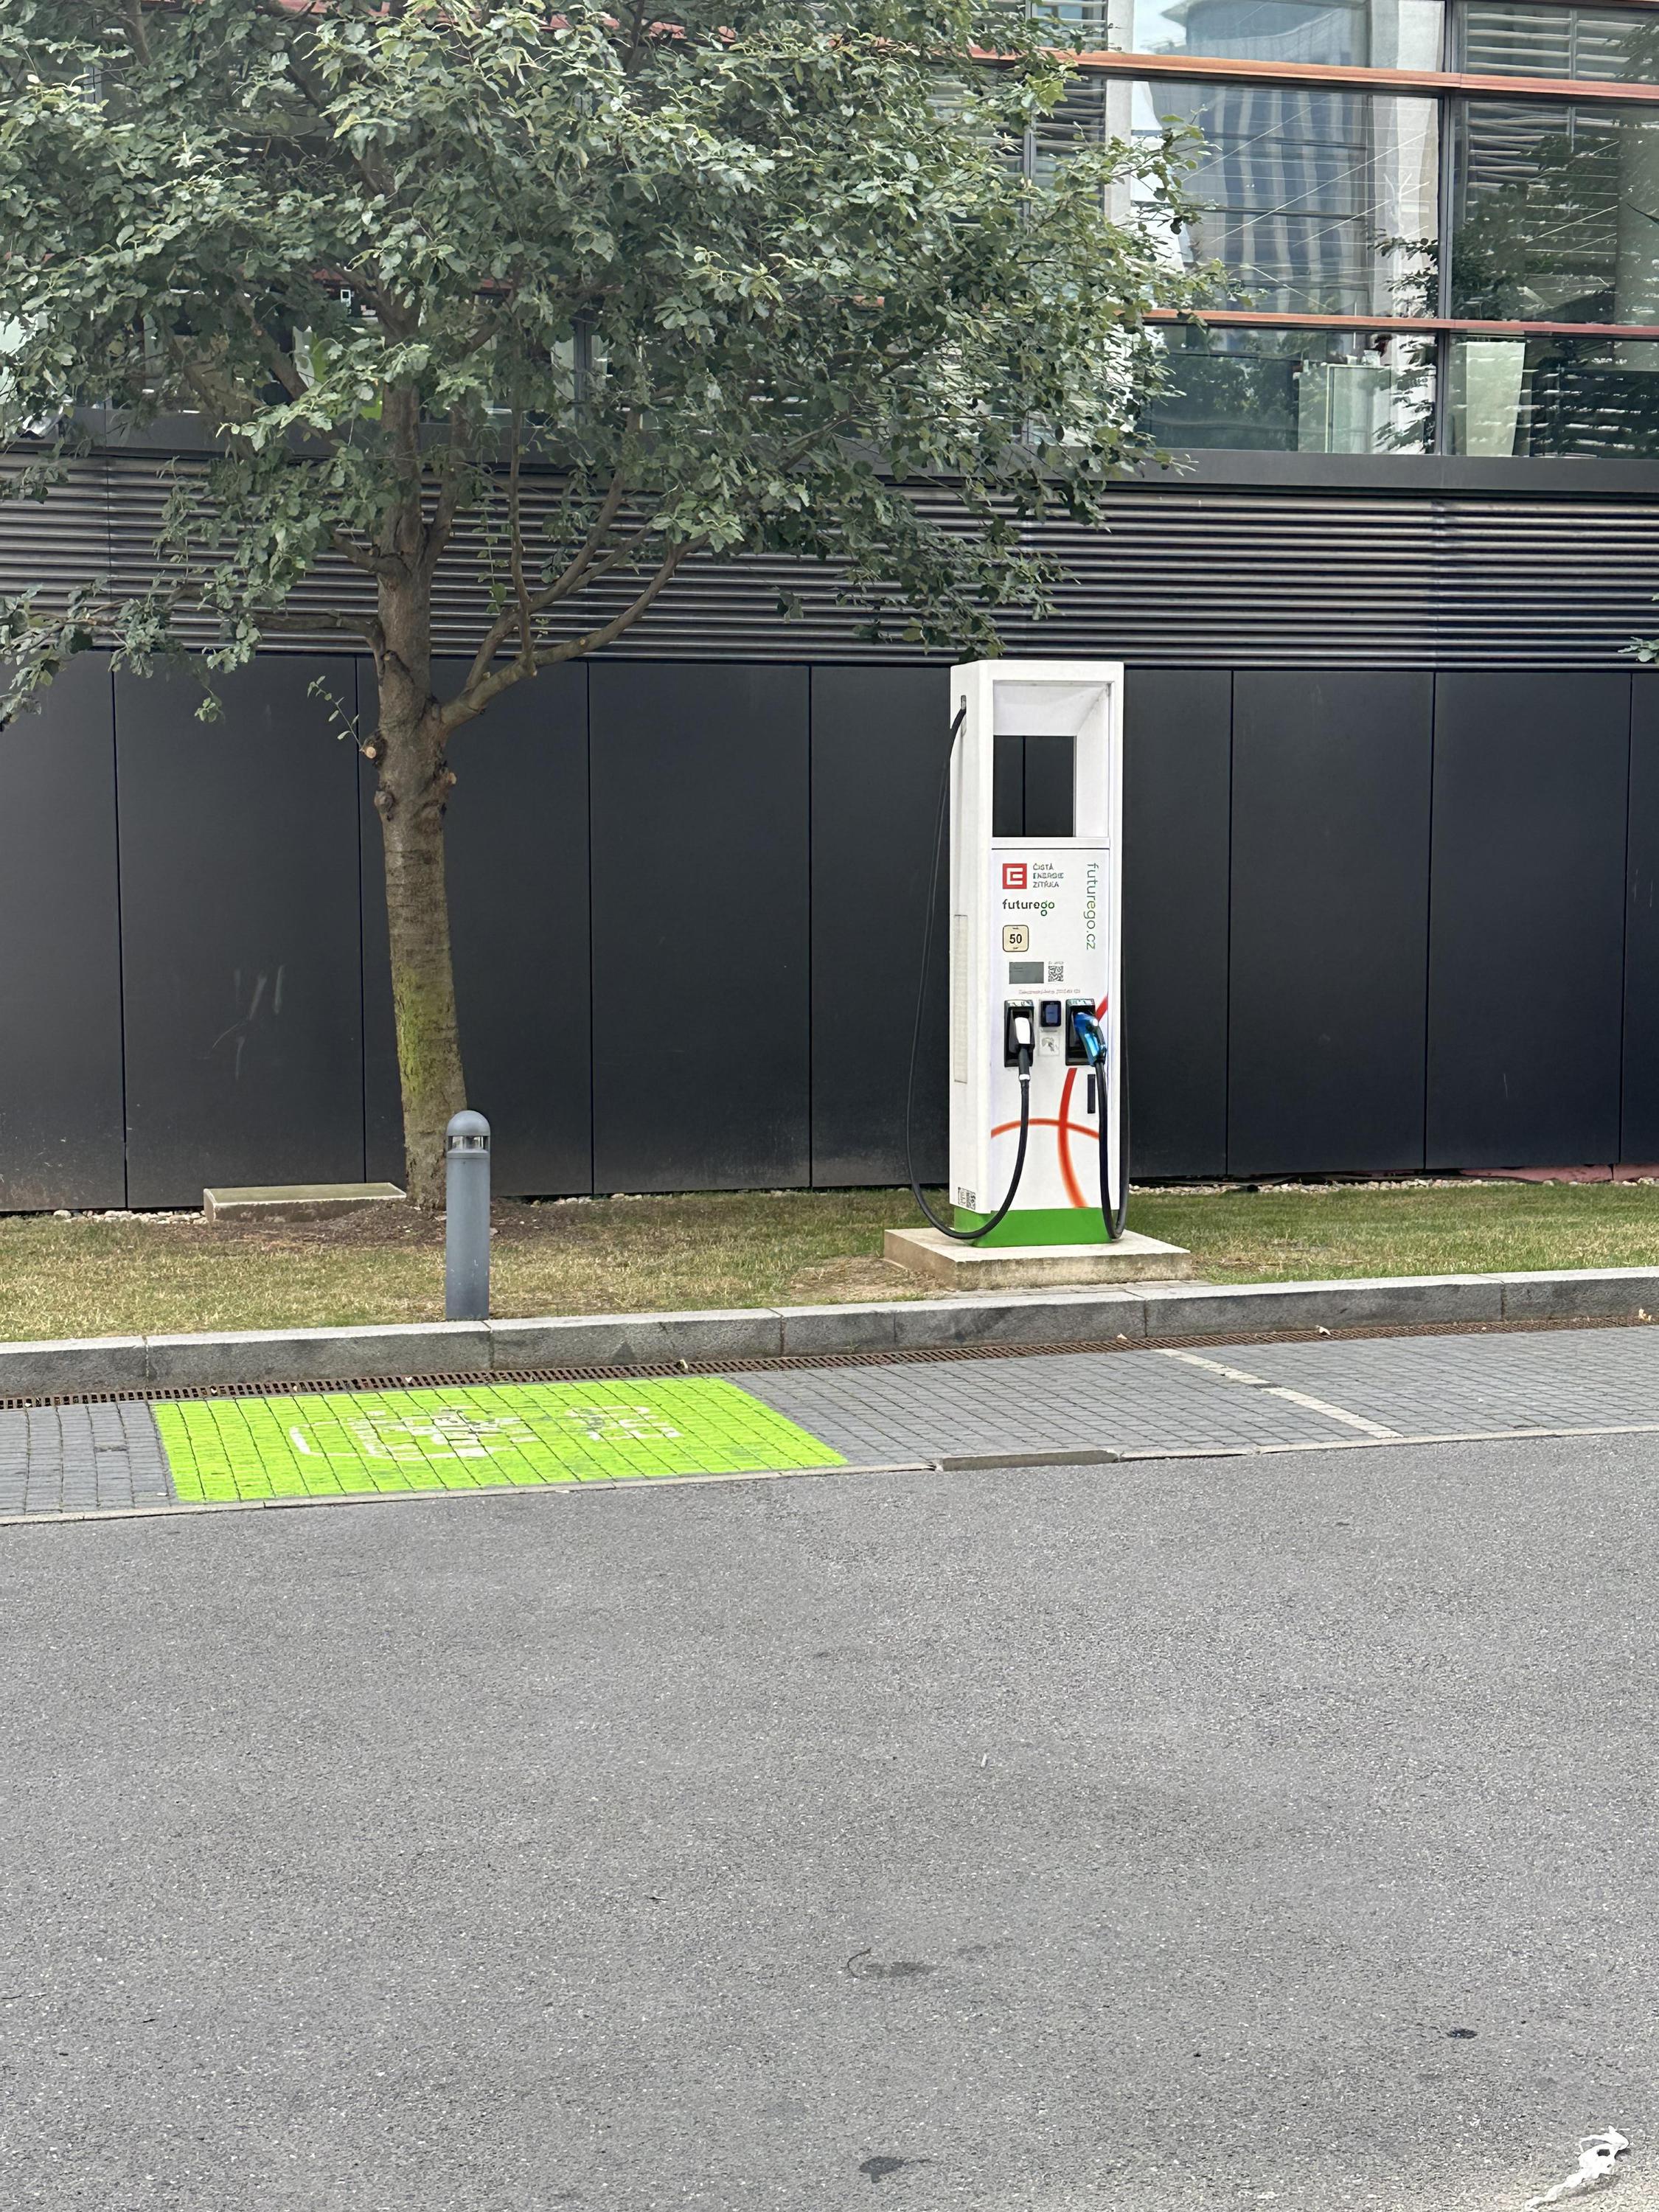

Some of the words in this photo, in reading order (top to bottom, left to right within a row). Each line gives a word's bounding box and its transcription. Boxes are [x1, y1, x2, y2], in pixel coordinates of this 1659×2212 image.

[1002, 899, 1055, 917] futurego
[1083, 863, 1099, 950] futurego.cz
[1009, 933, 1023, 944] 50
